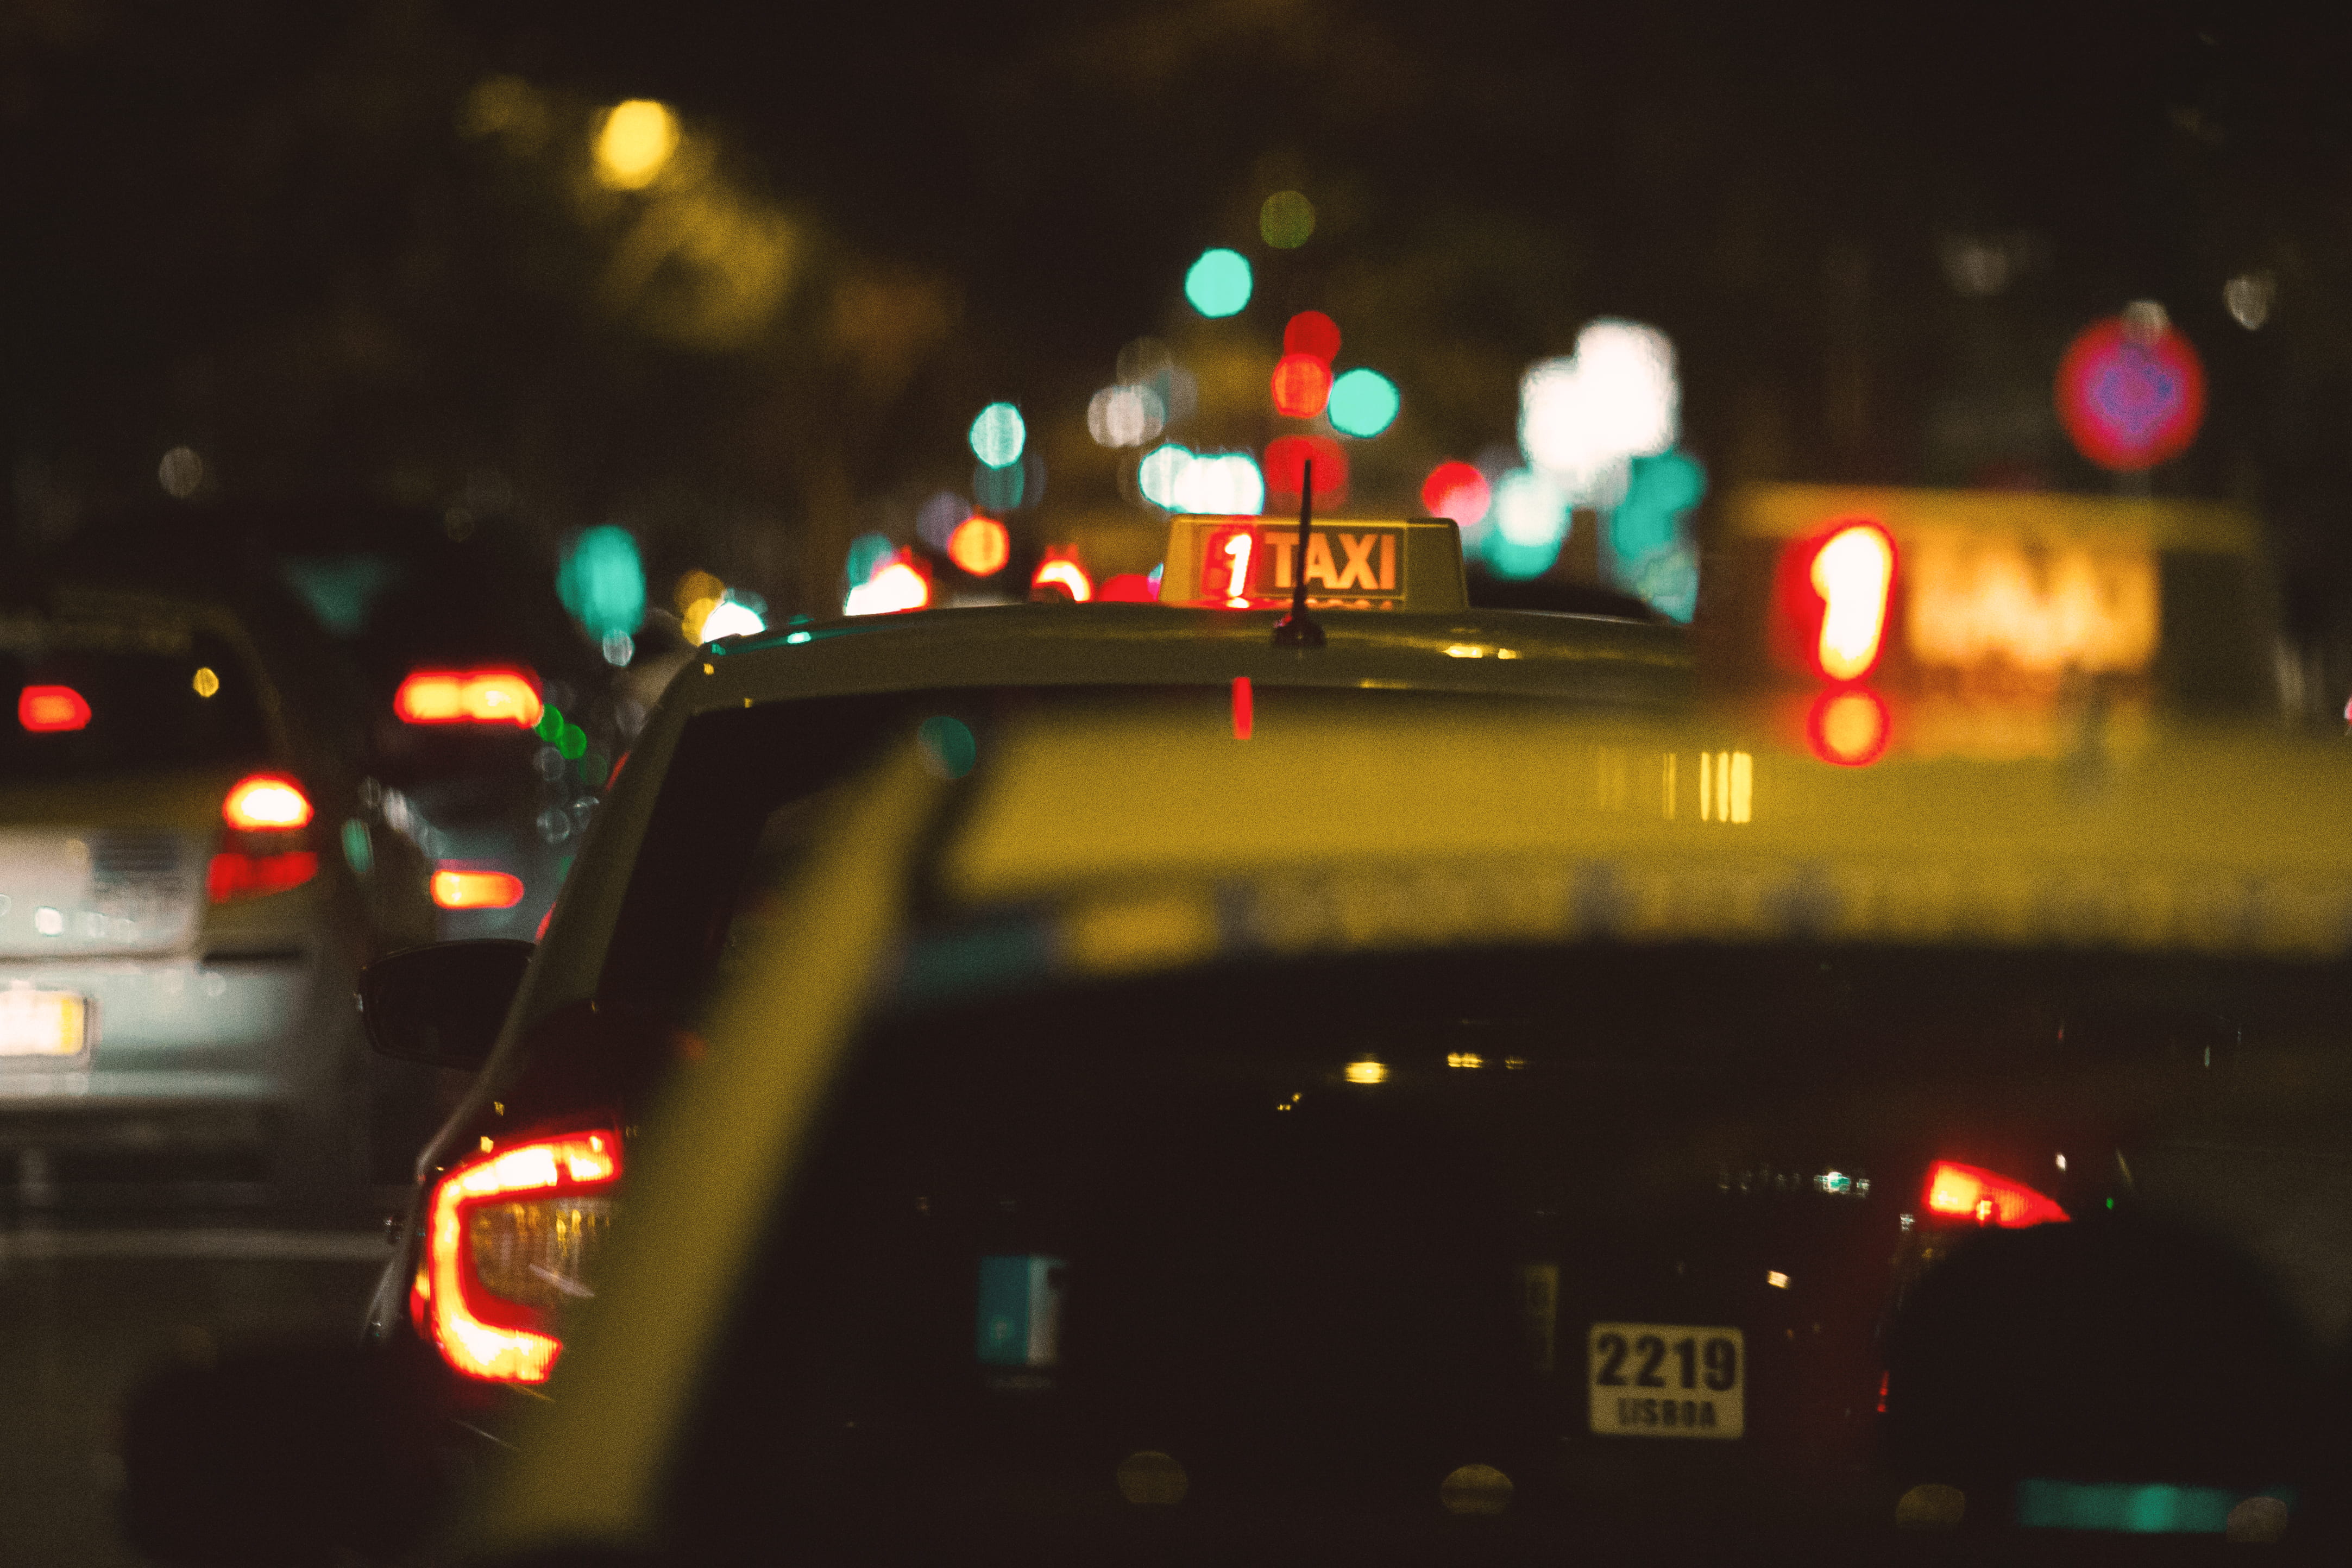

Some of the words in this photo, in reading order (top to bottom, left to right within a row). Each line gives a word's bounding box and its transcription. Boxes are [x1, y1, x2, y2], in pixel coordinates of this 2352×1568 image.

[1224, 533, 1253, 597] 1
[1264, 532, 1396, 590] TAXI
[1810, 524, 1894, 681] 1
[1596, 1332, 1737, 1391] 2219
[1617, 1397, 1718, 1428] LISBOA
